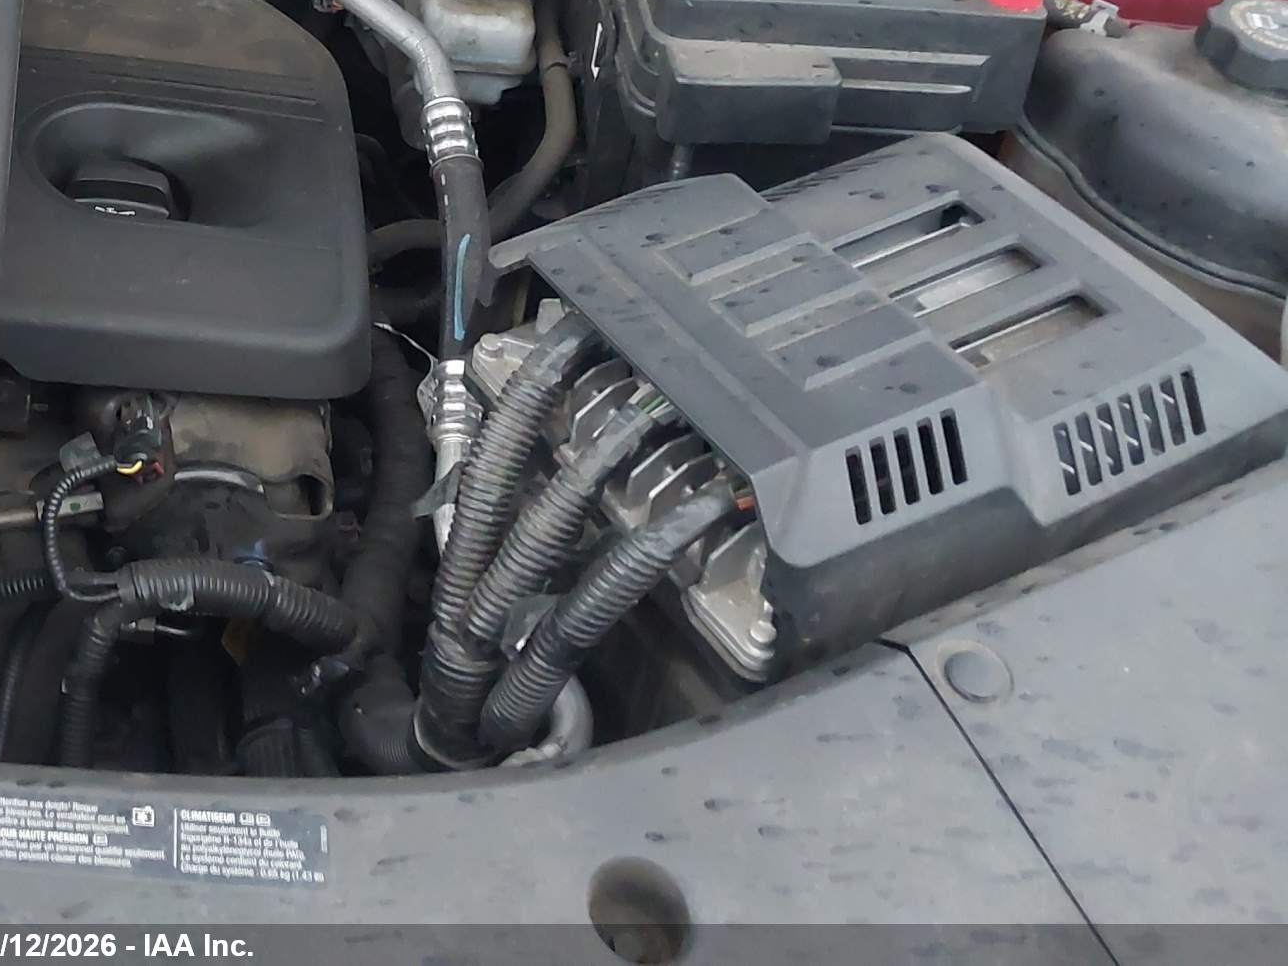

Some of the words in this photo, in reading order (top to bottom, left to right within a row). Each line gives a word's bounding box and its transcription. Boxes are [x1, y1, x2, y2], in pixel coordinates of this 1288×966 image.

[181, 809, 235, 825] CLIMATISEUR
[18, 830, 46, 843] HAUTE
[47, 831, 89, 845] PRESSION
